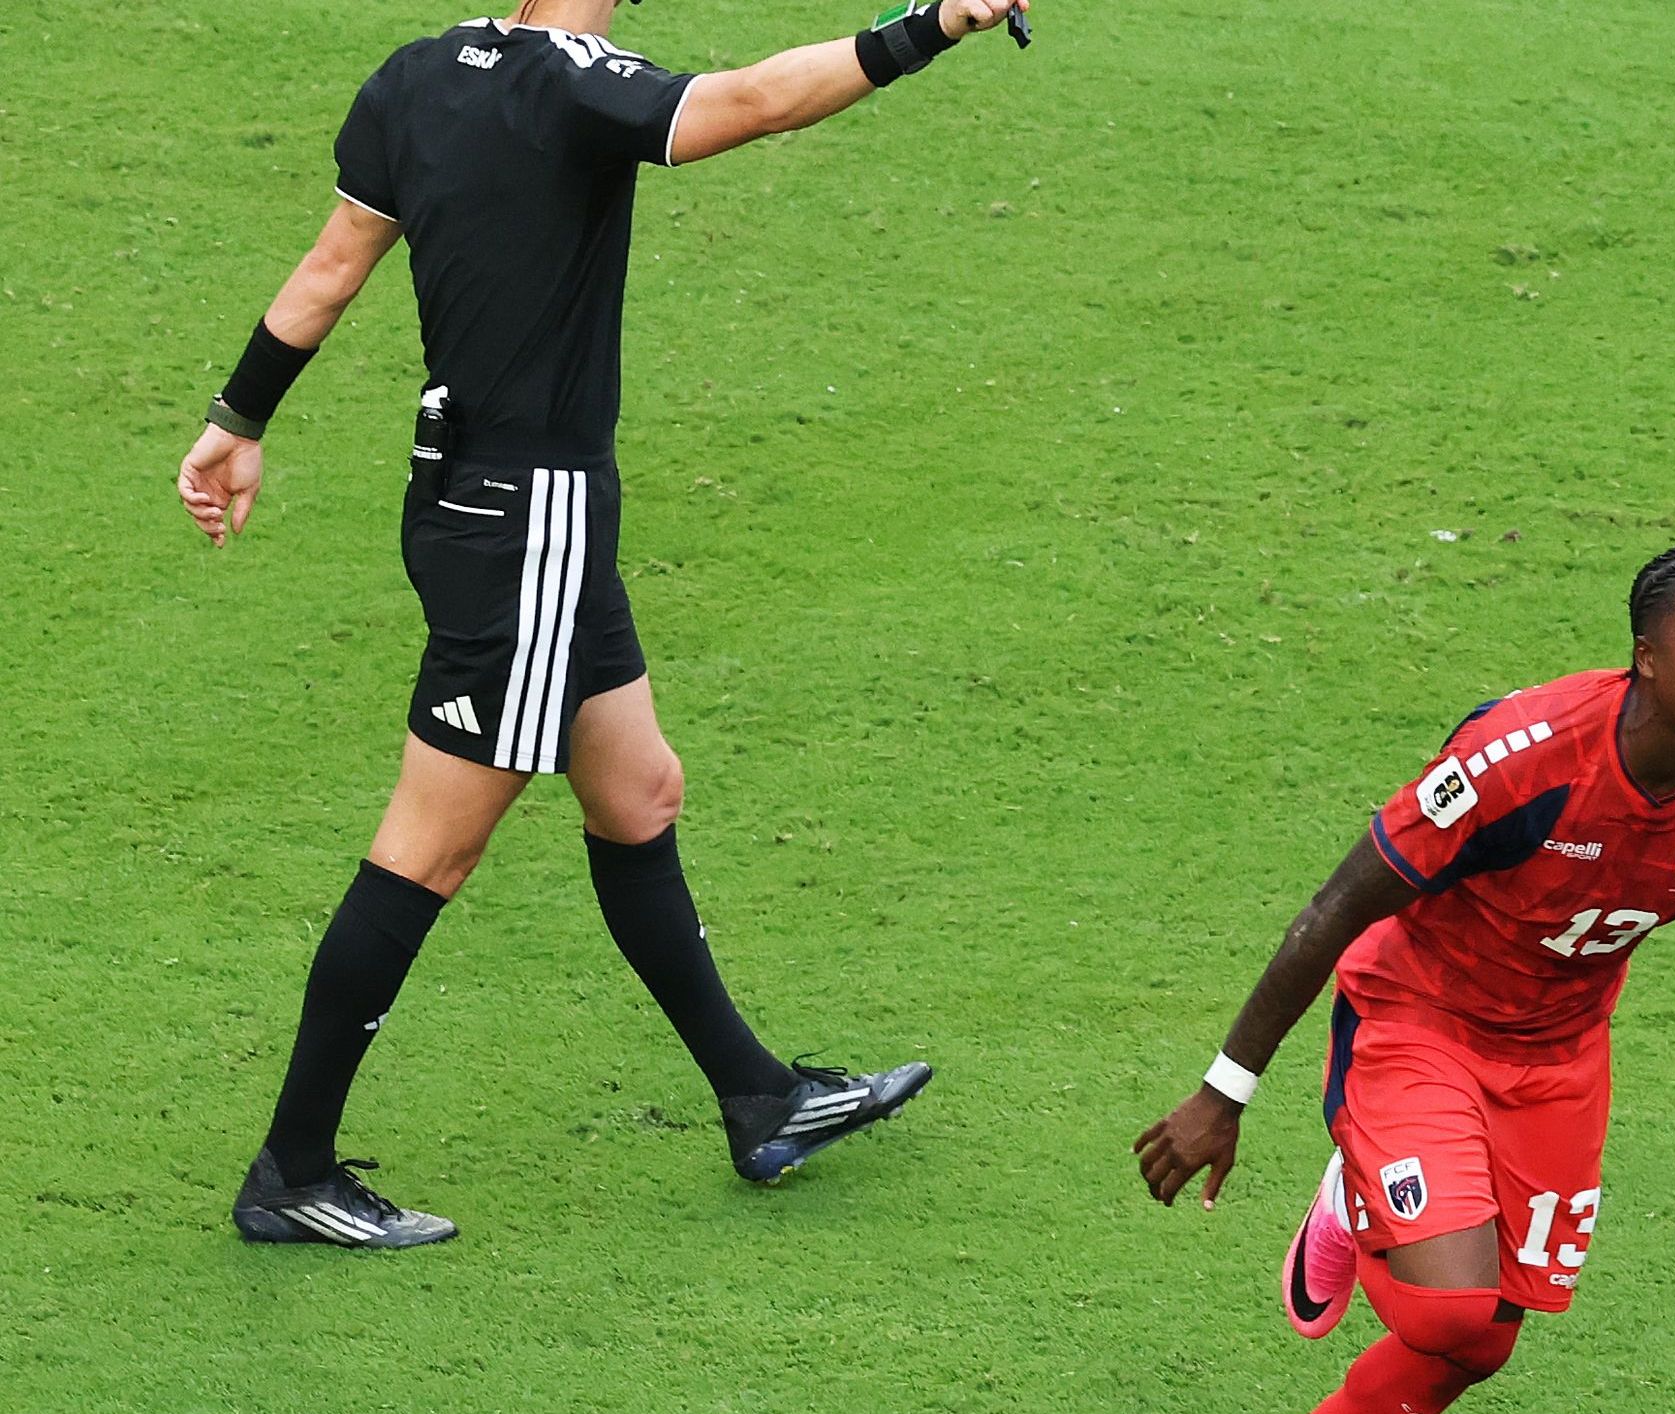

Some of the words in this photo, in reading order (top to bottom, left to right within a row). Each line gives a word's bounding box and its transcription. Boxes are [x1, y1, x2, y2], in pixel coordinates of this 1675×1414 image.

[1543, 839, 1603, 858] capelli
[1539, 908, 1660, 958] 13
[1383, 1161, 1417, 1179] FCF
[1517, 1186, 1601, 1268] 13
